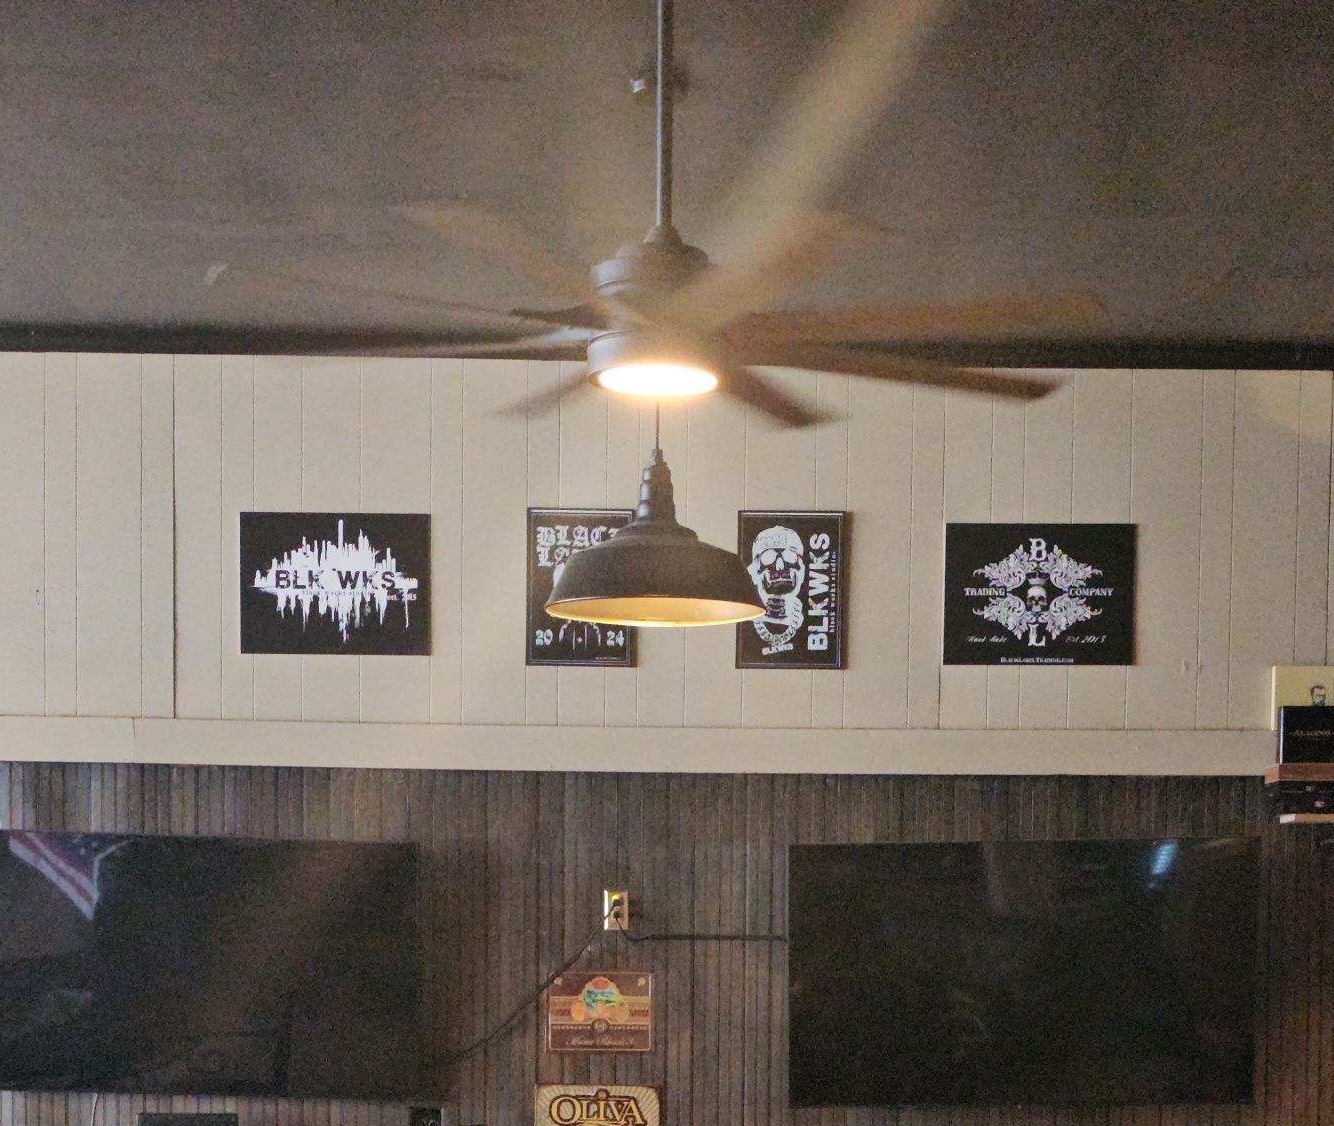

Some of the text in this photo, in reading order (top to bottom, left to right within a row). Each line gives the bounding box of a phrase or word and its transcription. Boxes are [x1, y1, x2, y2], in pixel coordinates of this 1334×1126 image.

[275, 569, 396, 590] BLK WKS
[807, 533, 830, 651] BLKWKS
[963, 587, 1005, 597] TRADING
[1068, 587, 1114, 597] COMPANY
[549, 1095, 647, 1126] OLIVA
